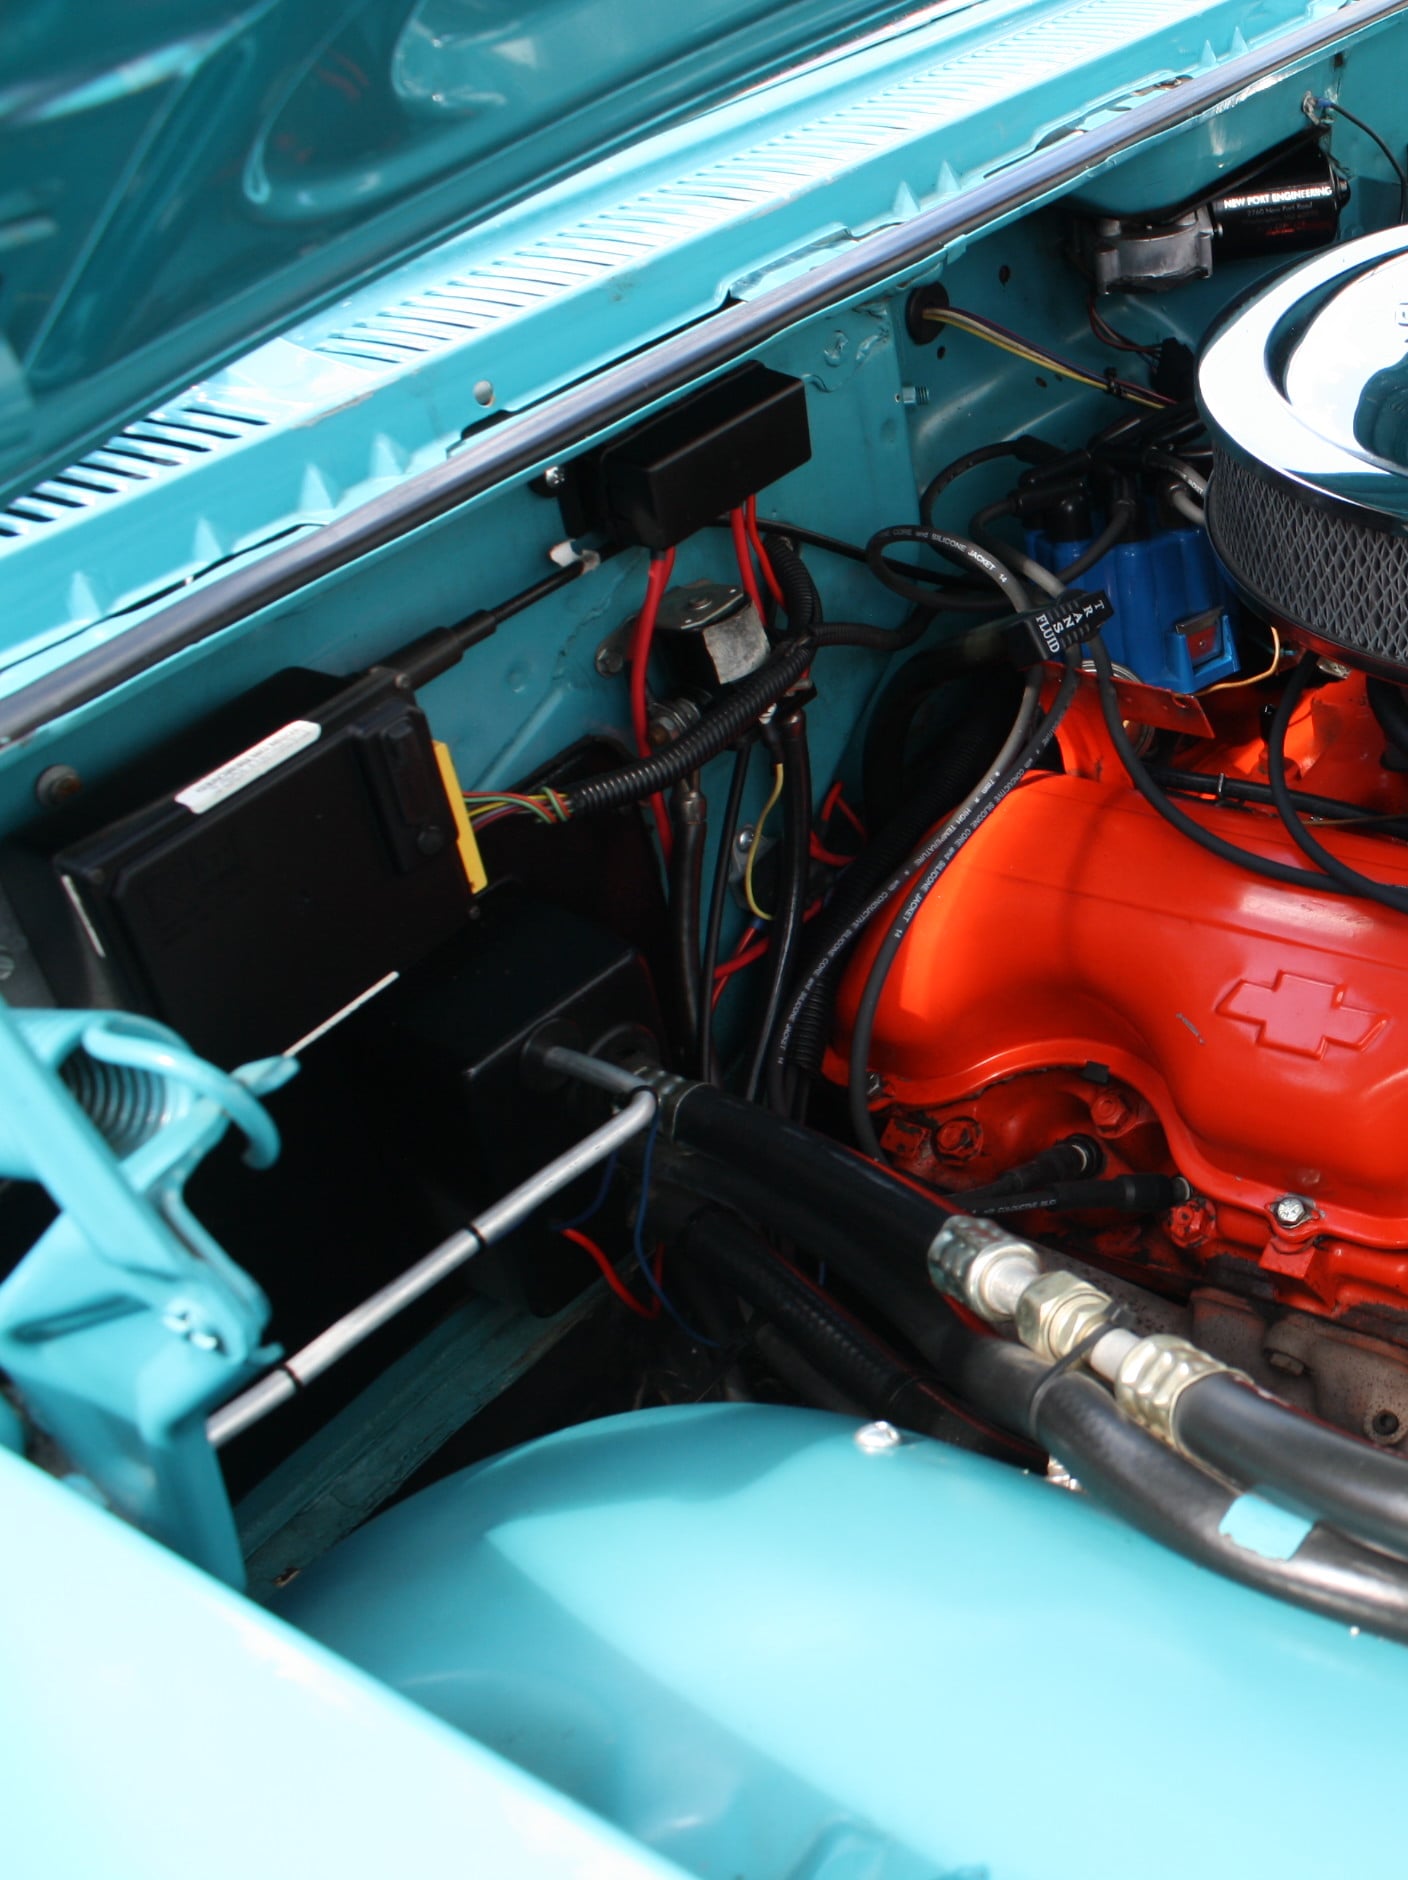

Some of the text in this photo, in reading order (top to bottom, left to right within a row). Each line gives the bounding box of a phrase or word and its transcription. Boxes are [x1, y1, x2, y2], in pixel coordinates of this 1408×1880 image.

[1271, 185, 1333, 203] ENGINEERING
[931, 532, 968, 553] SILICONE
[967, 550, 997, 572] JACKET
[1036, 613, 1061, 653] FLUID
[902, 892, 923, 923] JACKET
